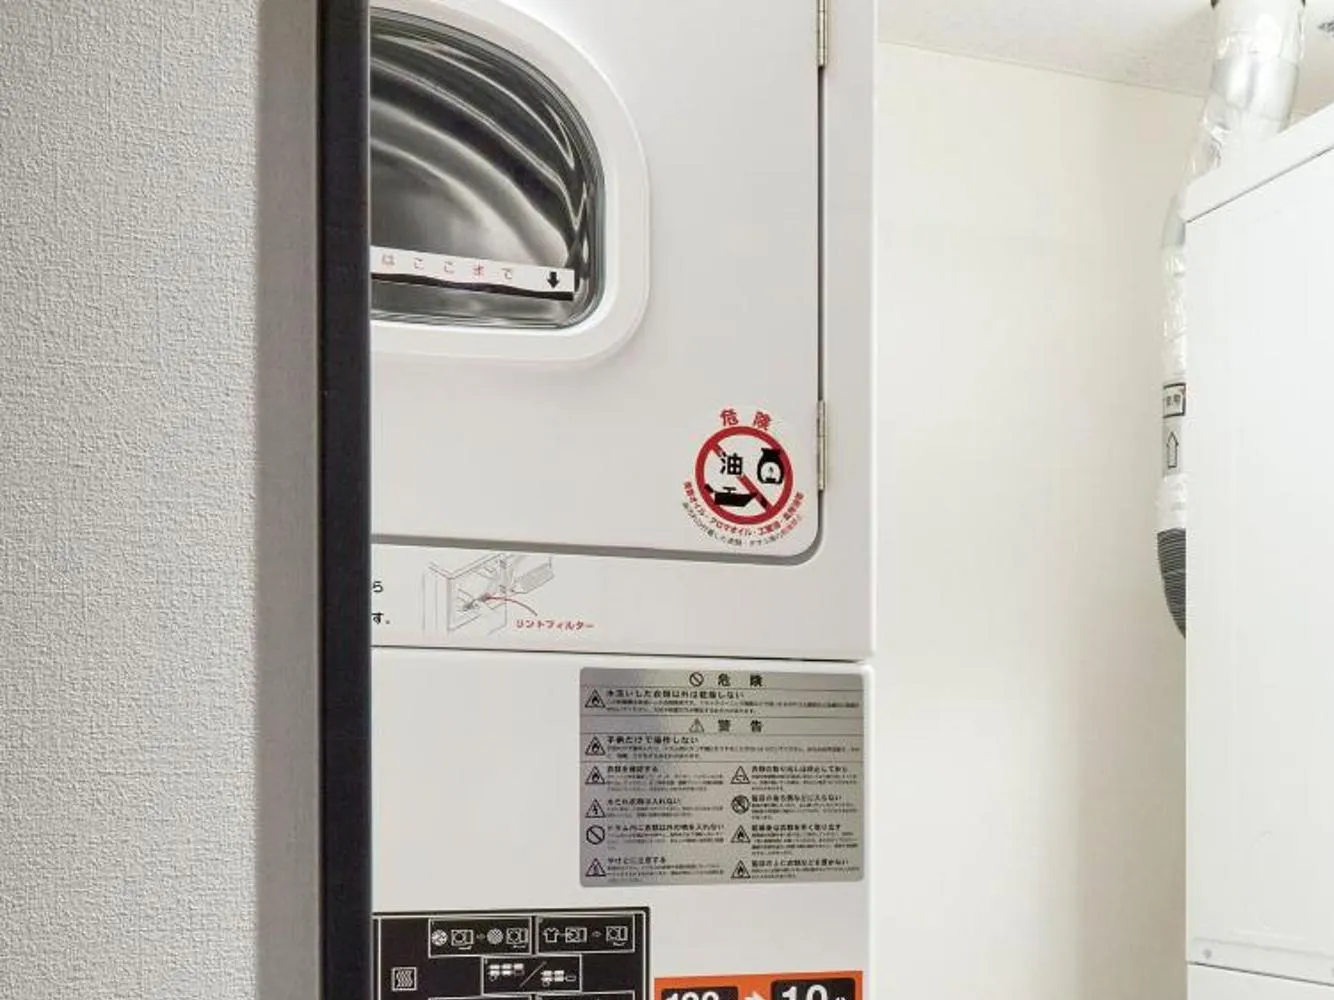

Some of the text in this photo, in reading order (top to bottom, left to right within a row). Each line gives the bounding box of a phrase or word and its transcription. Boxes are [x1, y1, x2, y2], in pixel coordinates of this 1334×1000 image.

[719, 408, 772, 430] 危険
[720, 453, 743, 475] 油
[516, 618, 594, 630] リントフィルター
